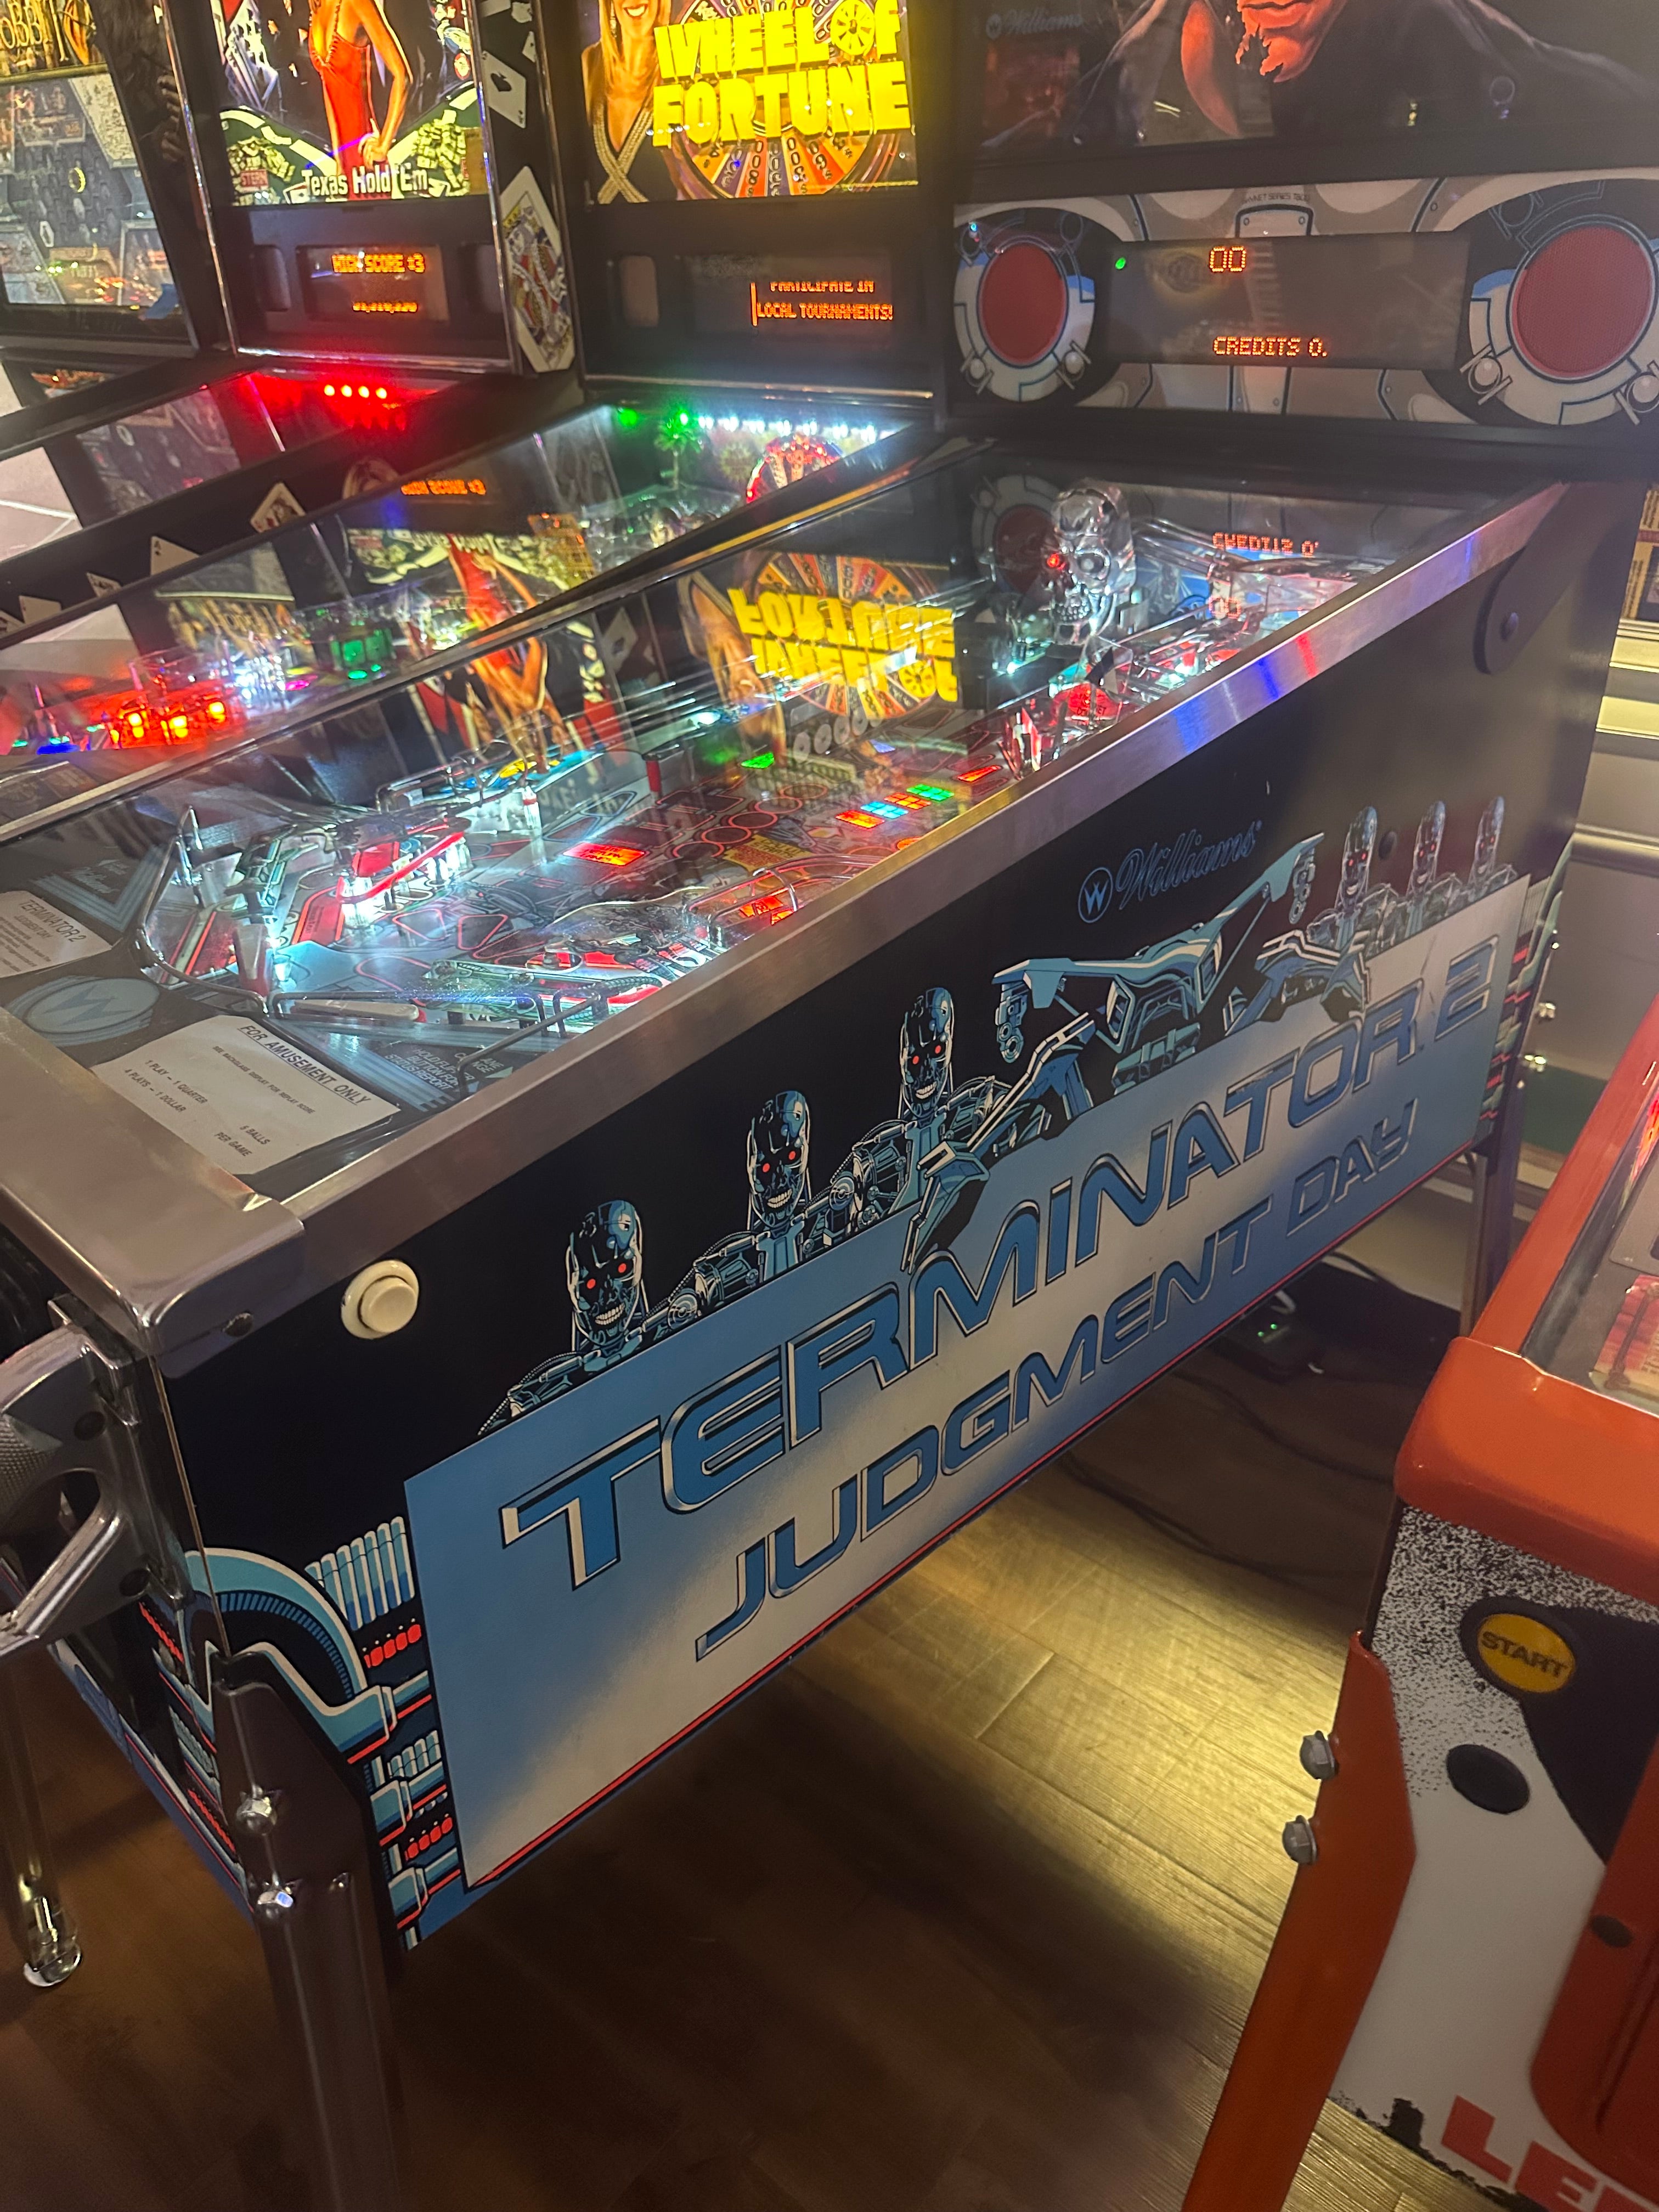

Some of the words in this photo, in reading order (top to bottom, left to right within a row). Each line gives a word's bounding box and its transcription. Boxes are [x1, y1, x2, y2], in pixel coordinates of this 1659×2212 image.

[654, 7, 830, 78] WHEEL
[831, 0, 901, 57] OF
[653, 60, 911, 147] FORTUNE
[241, 171, 268, 187] STERN
[302, 169, 348, 196] Texas
[364, 253, 405, 273] SCORE
[1209, 246, 1246, 272] 00
[757, 302, 797, 318] LOCAL
[799, 303, 894, 320] TOURNAMENTS!
[1213, 336, 1301, 356] CREDITS
[1115, 821, 1260, 911] Williams
[19, 899, 81, 939] TERMINATOR
[68, 934, 87, 943] 2
[240, 1024, 268, 1041] FOR
[264, 1041, 337, 1085] AMUSEMENT
[334, 1084, 371, 1105] ONLY
[385, 1053, 419, 1074] STATUS
[414, 1069, 454, 1090] REPORT
[407, 1055, 444, 1077] BUTTON
[439, 1072, 459, 1086] FOR
[411, 1048, 441, 1064] HOLD
[128, 1072, 151, 1088] PLAYS
[160, 1093, 187, 1113] DOLLAR
[149, 1063, 170, 1076] PLAY
[177, 1084, 208, 1104] QUARTER
[278, 1092, 298, 1105] REPLAY
[297, 1103, 315, 1114] SCORE
[214, 1132, 232, 1143] PER
[228, 1141, 253, 1157] GAME
[245, 1128, 271, 1146] BALLS
[499, 980, 1423, 1590] TERMINATOR
[1435, 934, 1499, 1041] 2
[696, 1195, 1273, 1662] JUDGMENT
[1286, 1097, 1419, 1238] DAY
[1481, 1629, 1569, 1677] START
